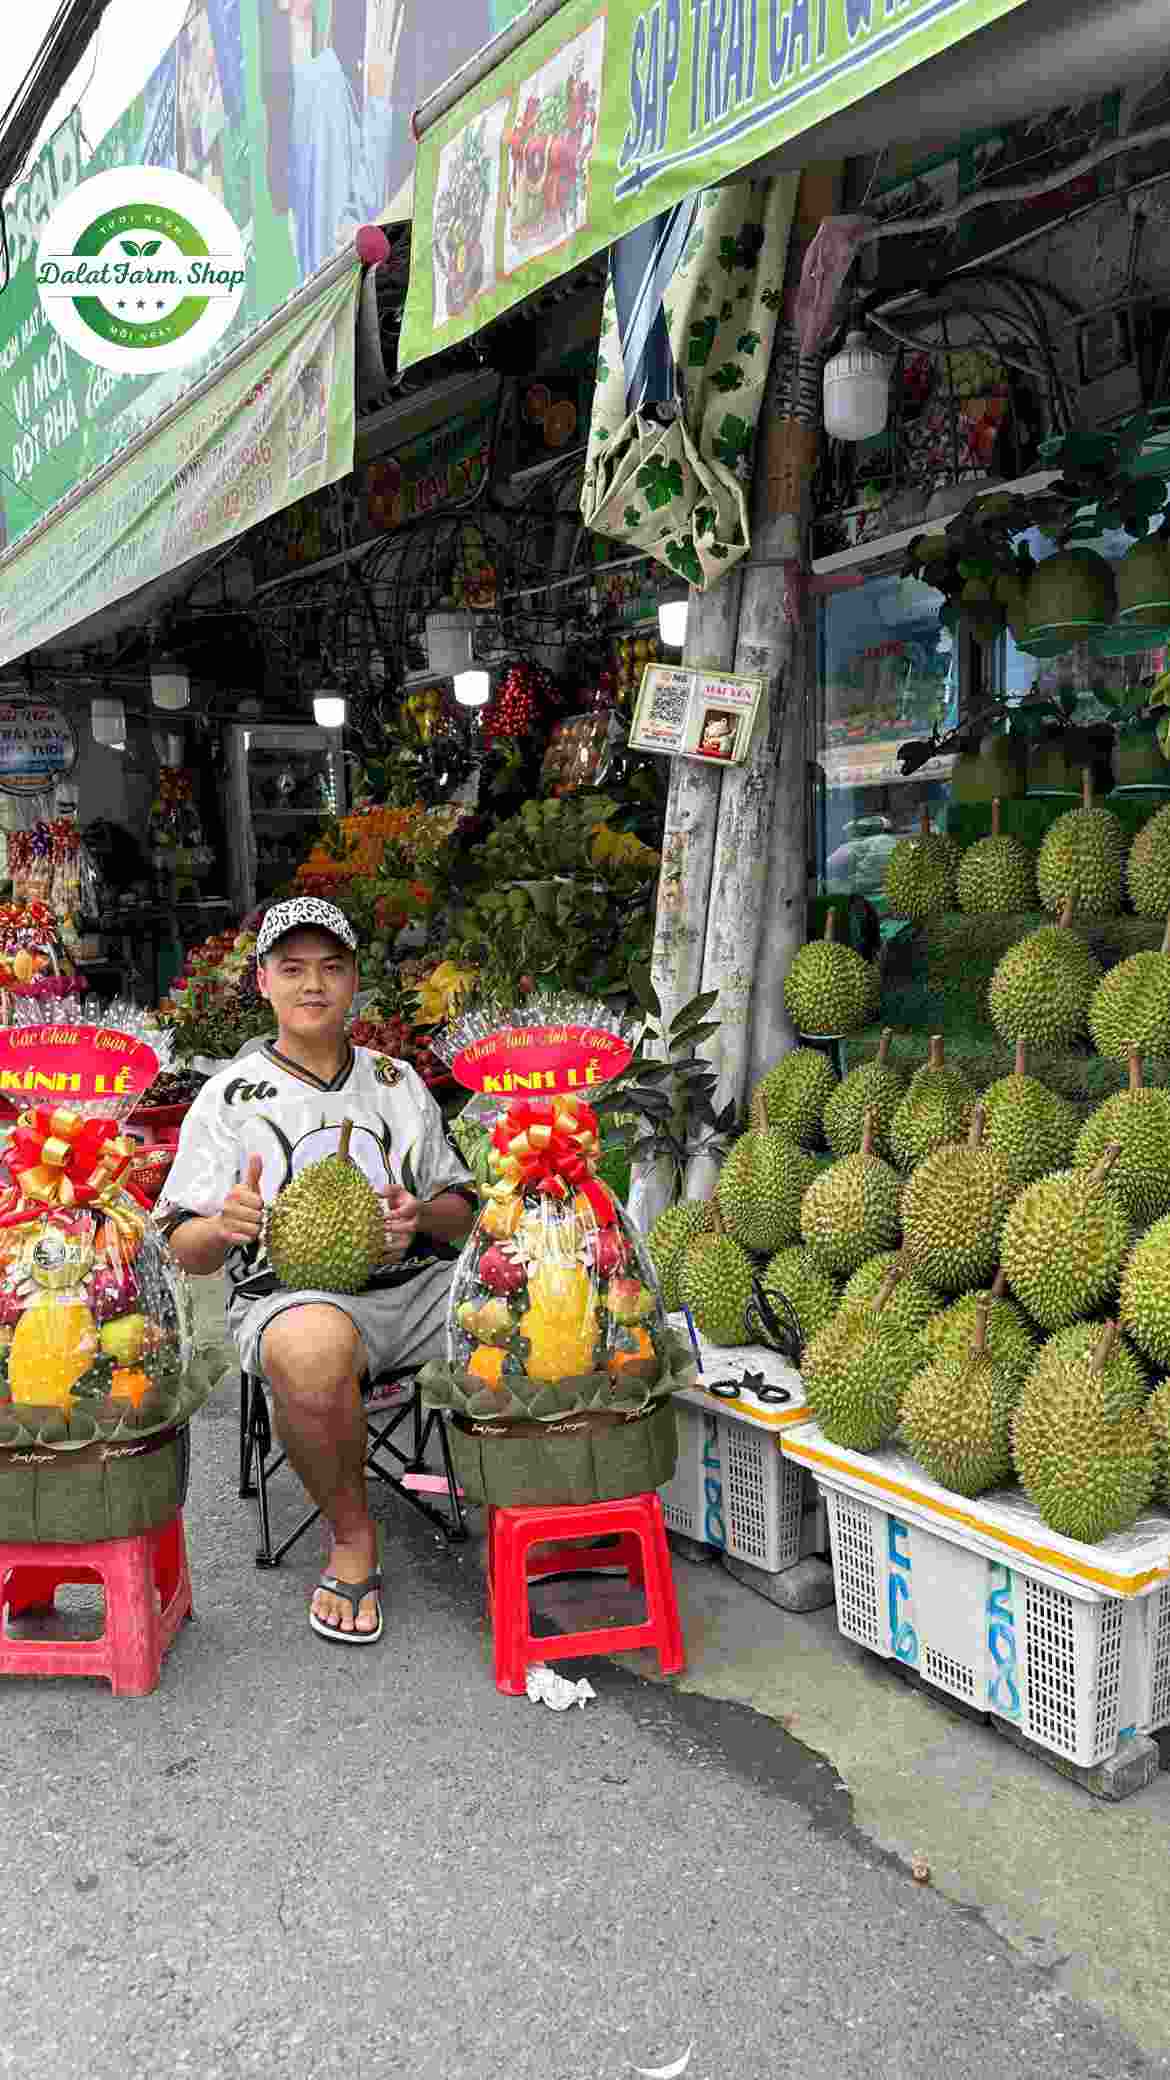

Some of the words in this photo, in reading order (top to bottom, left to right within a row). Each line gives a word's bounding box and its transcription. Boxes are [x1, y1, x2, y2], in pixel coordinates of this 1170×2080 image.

[0, 1063, 81, 1091] KÍNH
[95, 1063, 135, 1094] LỄ
[482, 1068, 557, 1093] KÍNH
[567, 1057, 604, 1087] LỄ
